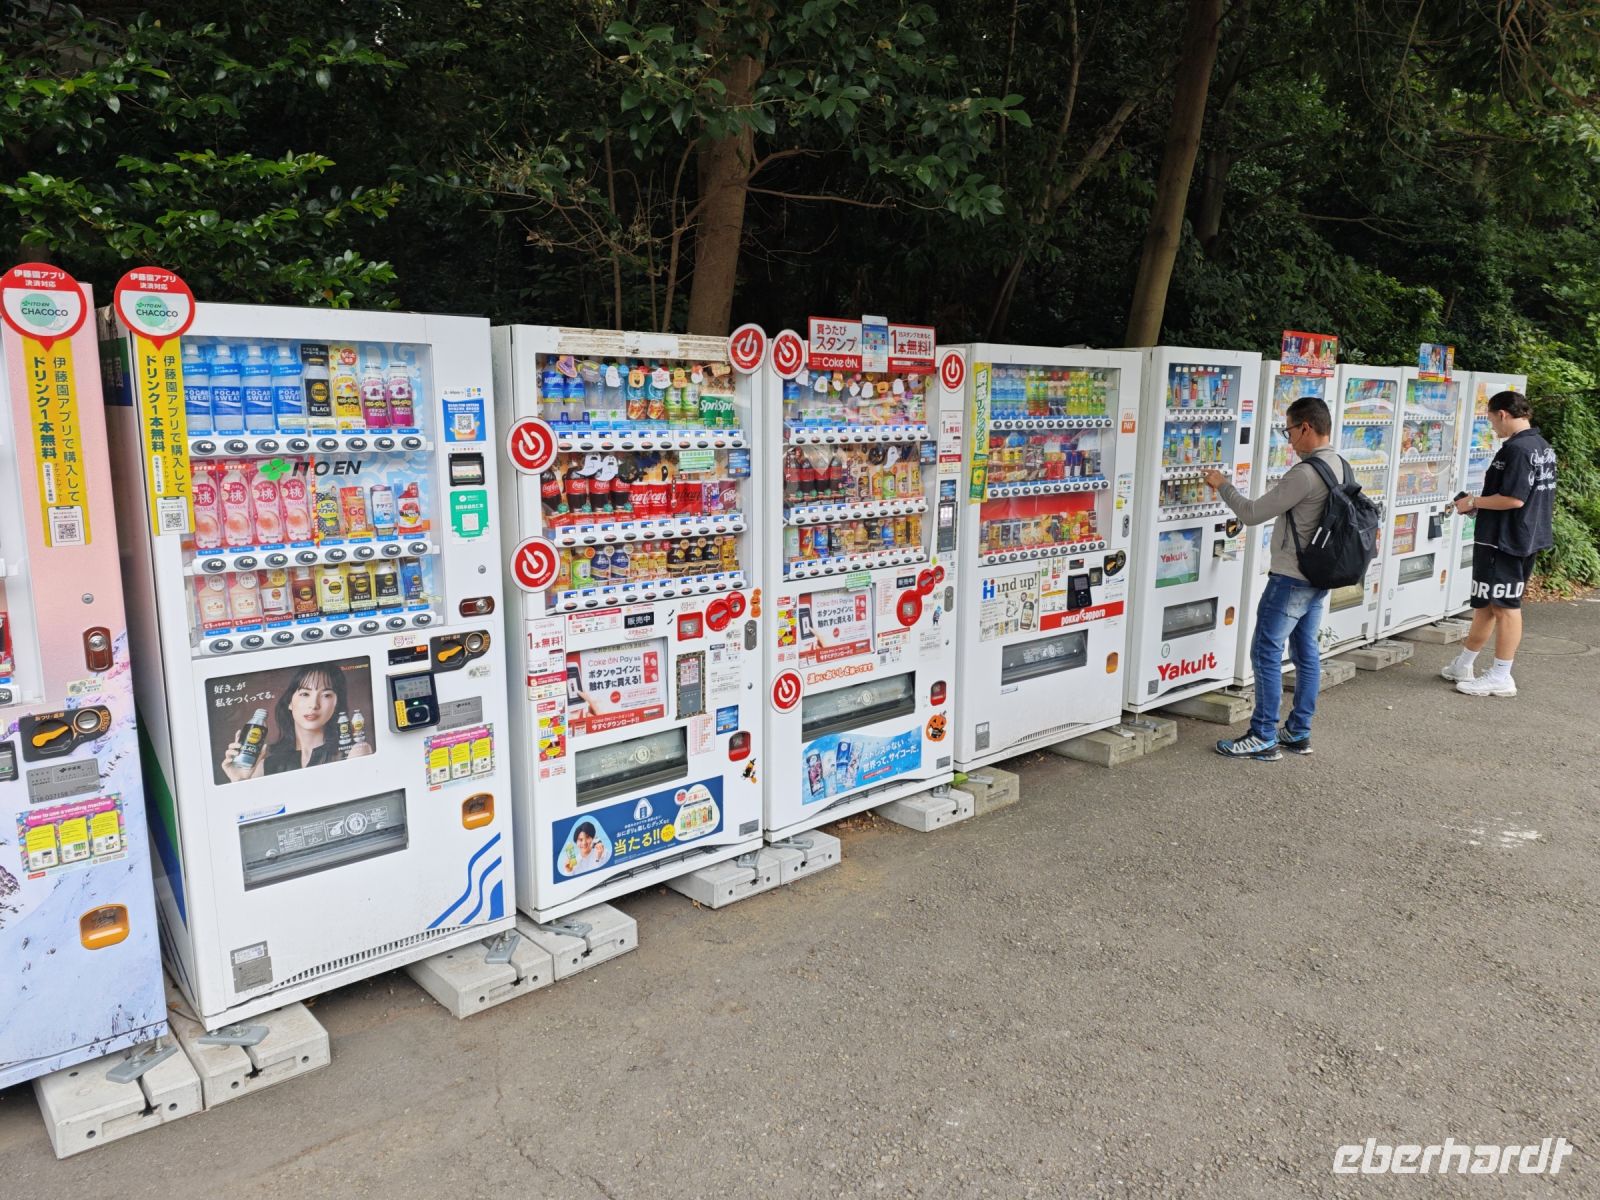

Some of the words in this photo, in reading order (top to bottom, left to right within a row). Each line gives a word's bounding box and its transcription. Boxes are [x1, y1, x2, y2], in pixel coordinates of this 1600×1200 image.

[13, 269, 65, 280] 伊藤園アプリ
[130, 273, 176, 283] 伊藤園アプリ
[21, 307, 68, 316] CHACOCO
[136, 309, 178, 317] CHACOCO
[816, 323, 847, 336] 買うたび
[816, 336, 857, 351] スタンプ
[822, 357, 844, 367] Coke
[845, 356, 859, 368] ON
[33, 356, 57, 459] ドリンク1本無料
[146, 356, 165, 452] ドリンク1本無料
[53, 357, 80, 502] 伊藤園アプリで購入して
[164, 356, 185, 492] 伊藤園アプリで購入して
[1123, 421, 1133, 429] PAY
[292, 461, 330, 476] ITO
[333, 461, 362, 475] EN
[230, 490, 243, 502] 桃
[261, 489, 274, 500] 桃
[289, 487, 302, 498] 桃
[1161, 552, 1188, 563] Yakult
[1020, 571, 1038, 589] up!
[817, 606, 853, 617] ボタンやコインに
[627, 615, 651, 625] 販売中
[817, 616, 854, 628] 触れずに買える!
[527, 632, 563, 650] 1本無料!
[588, 659, 607, 667] Coke
[620, 655, 632, 663] Pay
[1157, 651, 1217, 681] Yakult
[589, 666, 640, 679] ボタンやコインに
[213, 681, 246, 695] 好き、が
[589, 675, 641, 691] 触れずに買える!
[215, 691, 275, 708] 私をつくってる。
[863, 741, 904, 760] ストレスのない
[65, 804, 87, 813] vending
[87, 800, 111, 809] machine
[614, 829, 660, 856] 当たる!!
